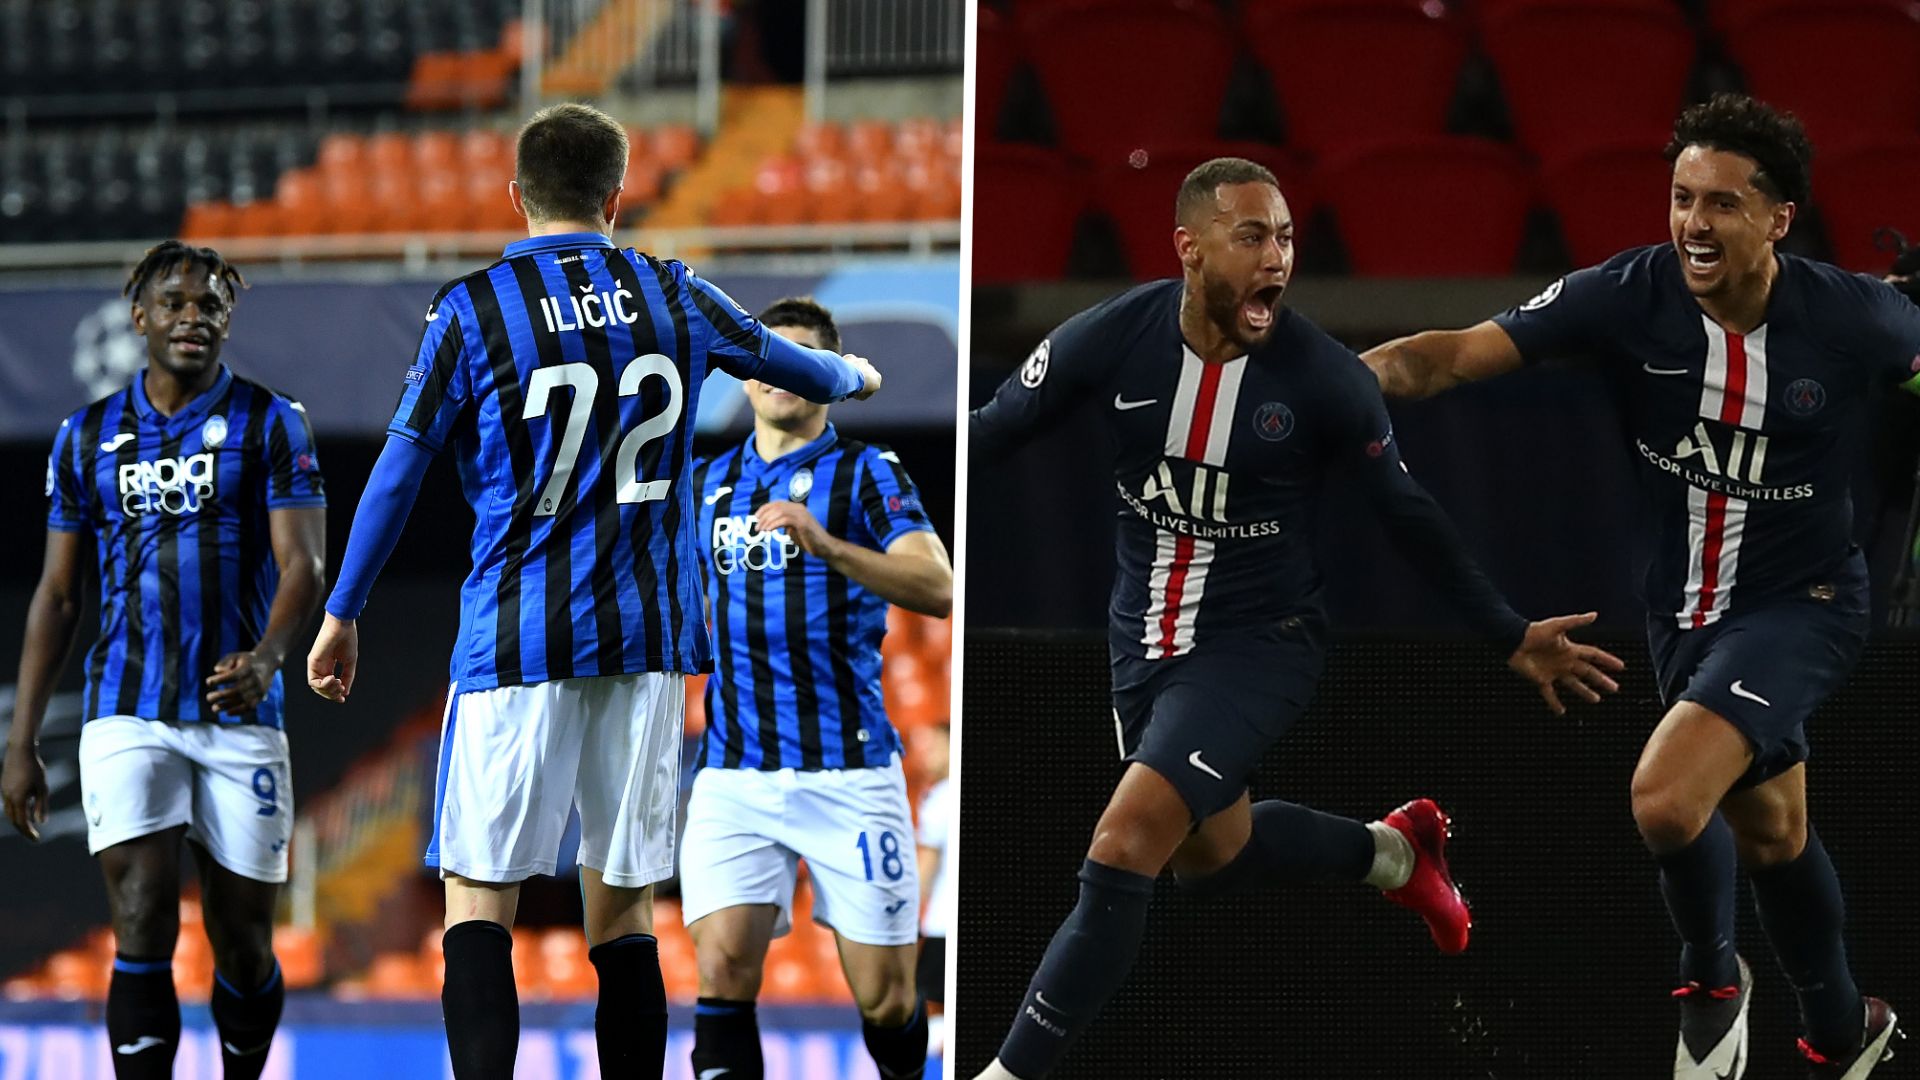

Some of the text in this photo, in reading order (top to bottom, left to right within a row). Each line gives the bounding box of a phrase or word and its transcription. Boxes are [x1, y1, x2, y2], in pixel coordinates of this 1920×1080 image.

[540, 279, 638, 332] ILIČIĆ
[522, 353, 683, 518] 72
[122, 481, 214, 518] GROUP
[1685, 470, 1720, 490] LIVE
[1726, 483, 1814, 501] LIMITLESS
[713, 515, 791, 549] RAD
[1152, 511, 1188, 534] LIVE
[1192, 521, 1280, 539] LIMITLESS
[714, 540, 800, 575] GROUP
[252, 767, 278, 816] 9
[856, 831, 903, 882] 18
